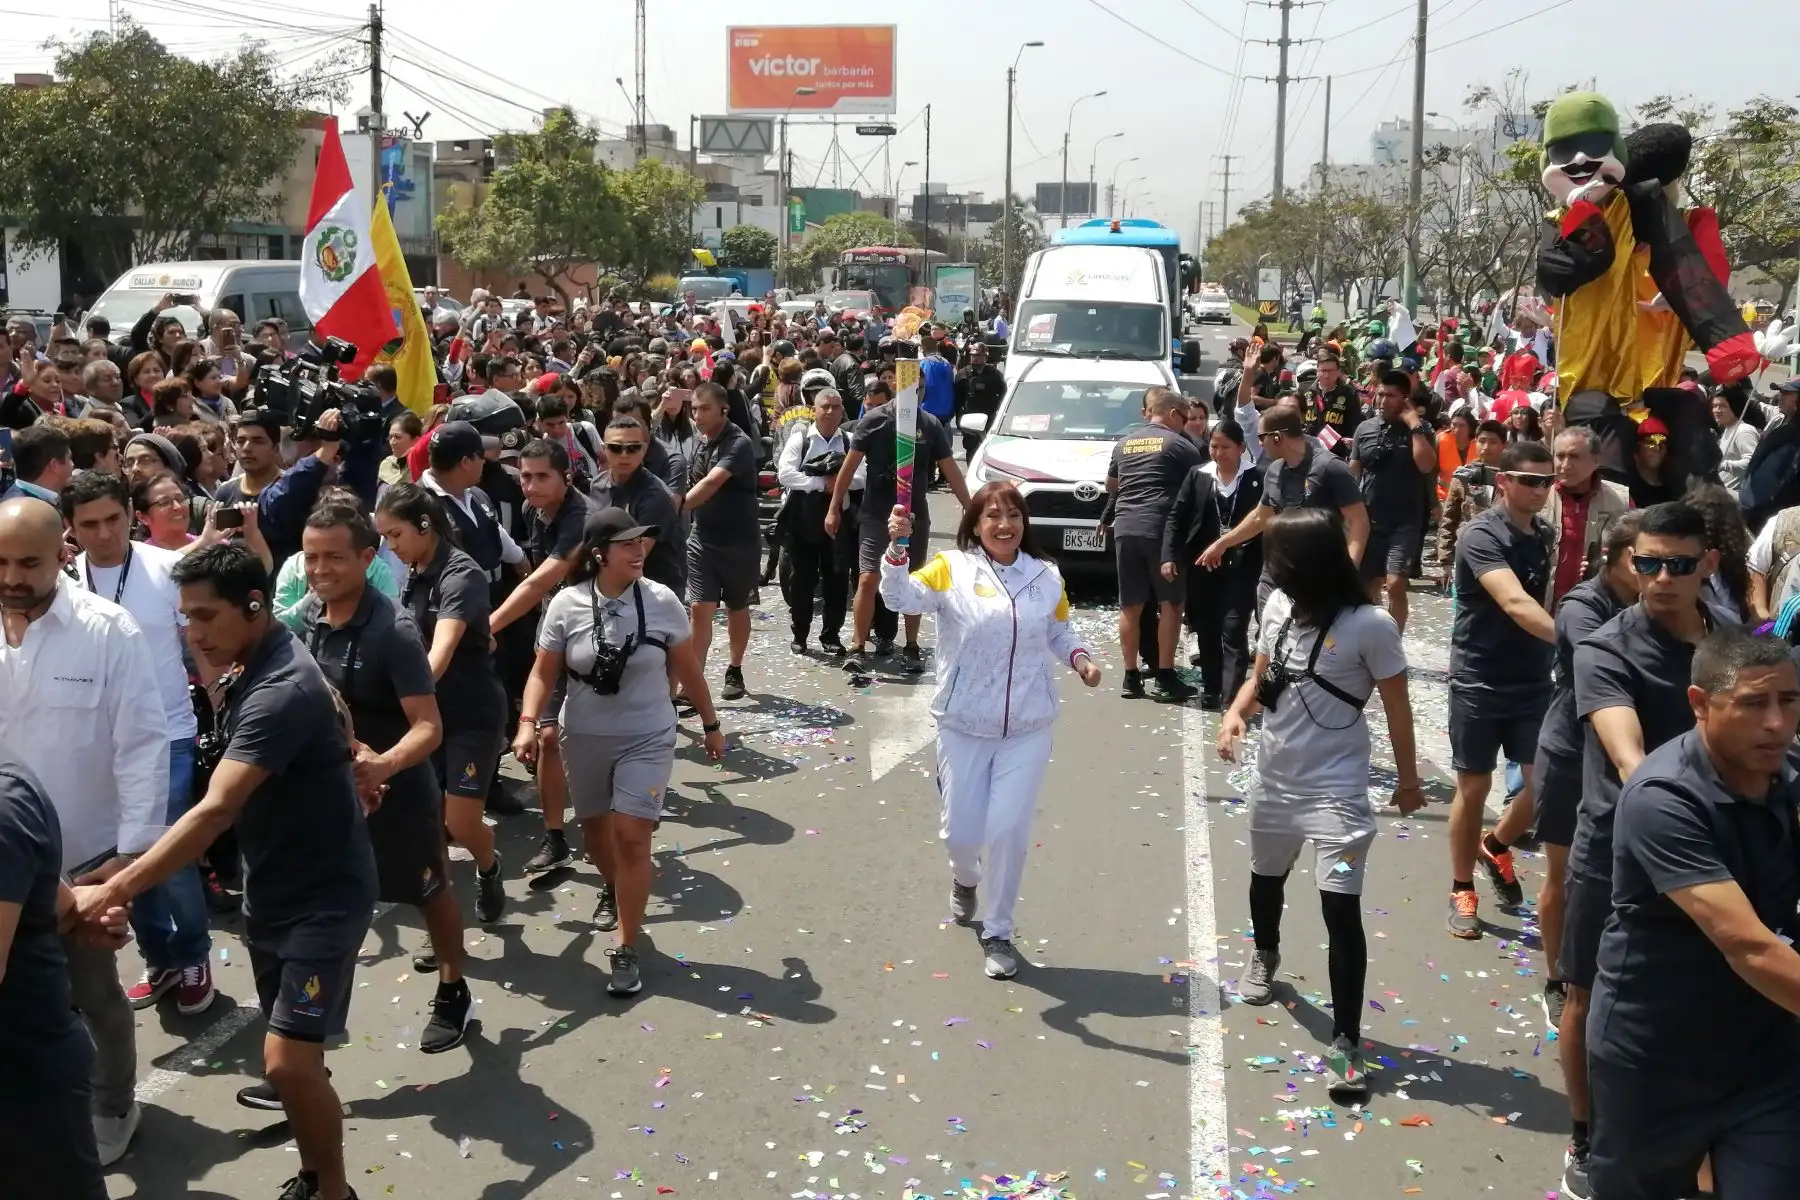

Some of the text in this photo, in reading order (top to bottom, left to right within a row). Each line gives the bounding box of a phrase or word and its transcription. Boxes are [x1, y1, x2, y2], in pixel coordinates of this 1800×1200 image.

[748, 53, 874, 76] víctor barbarán
[841, 82, 856, 90] por
[857, 80, 874, 89] más
[133, 276, 156, 286] CALLAO
[1125, 437, 1164, 447] MINISTERIO
[1123, 445, 1163, 455] DE DEFENSA
